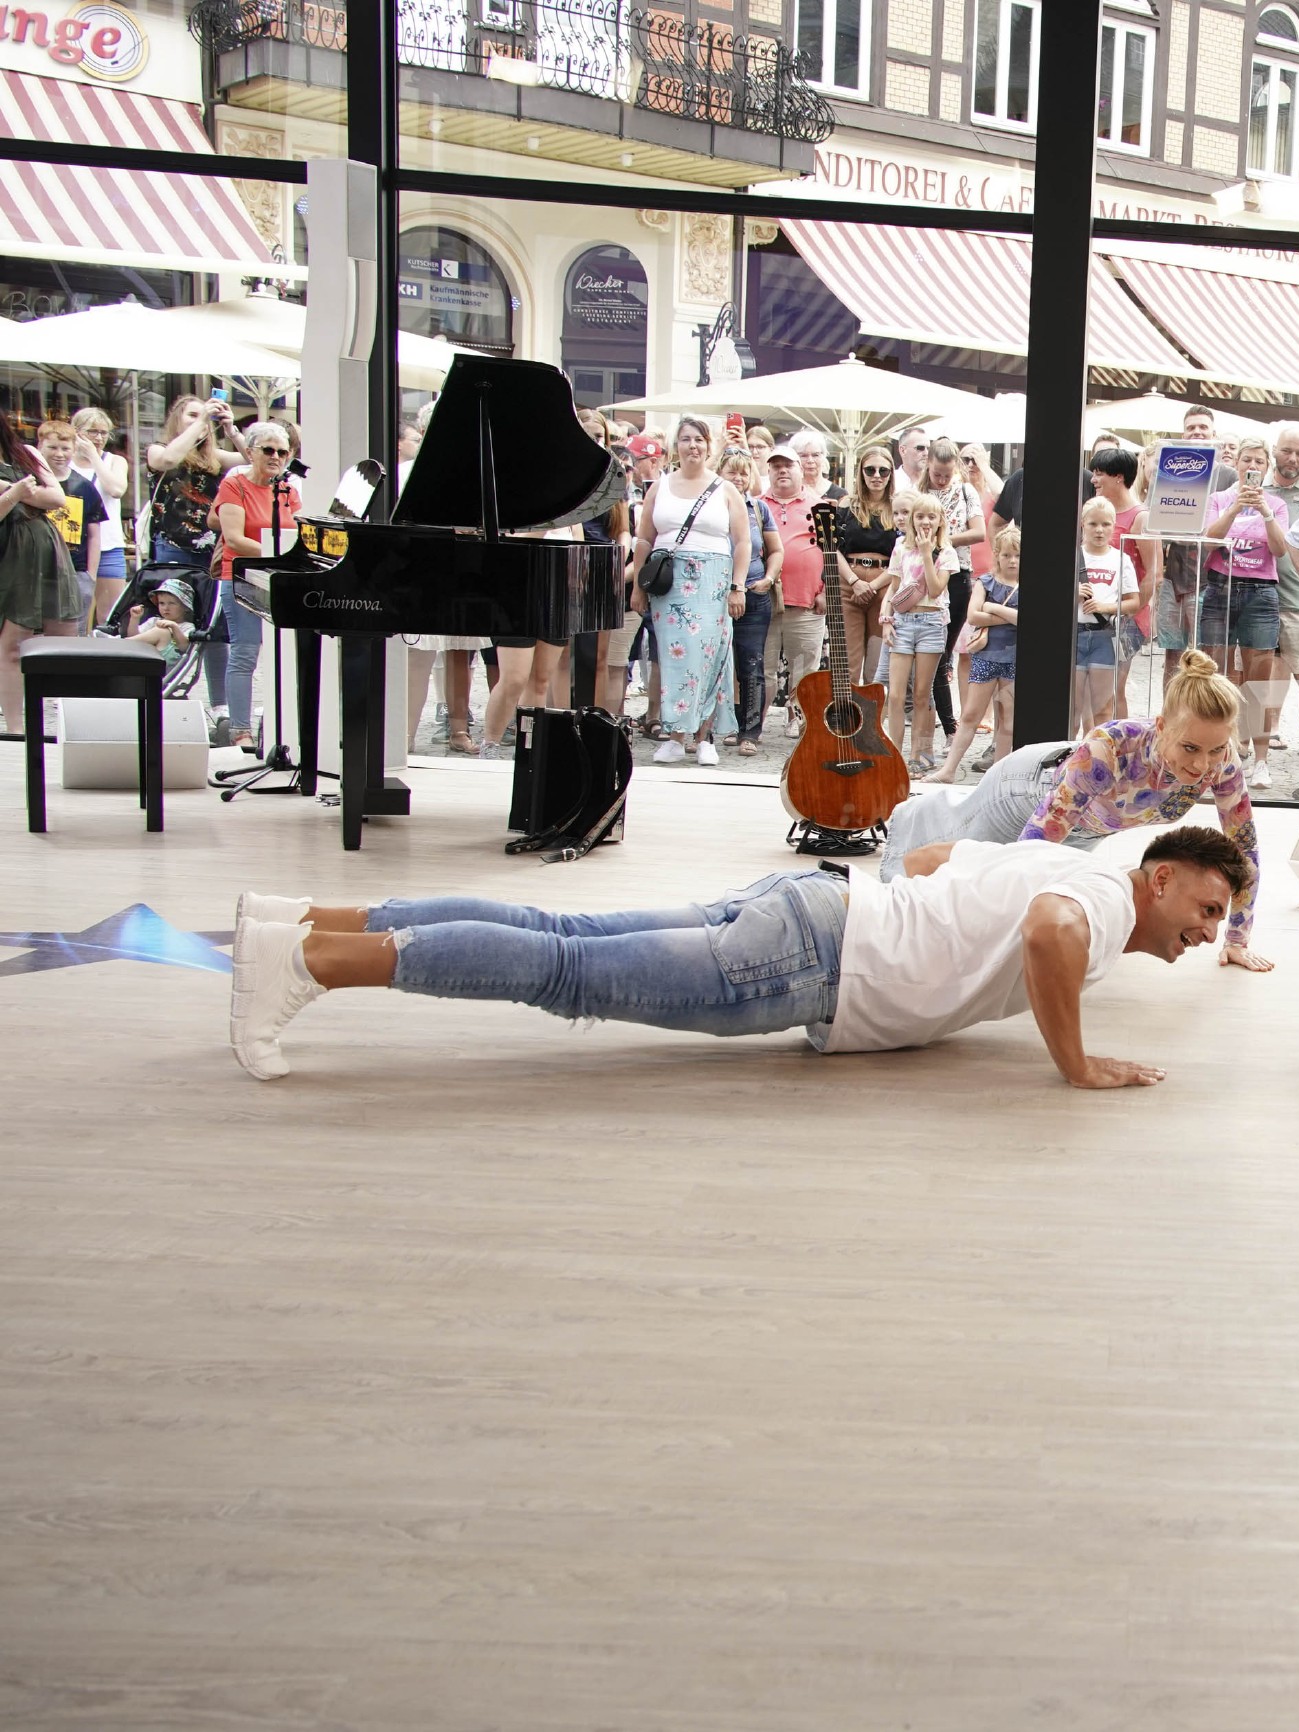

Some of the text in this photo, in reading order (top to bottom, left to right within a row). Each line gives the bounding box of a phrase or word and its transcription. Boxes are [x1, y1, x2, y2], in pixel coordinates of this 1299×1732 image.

[800, 150, 948, 204] NDITOREI
[954, 175, 972, 209] &
[430, 284, 490, 298] Kaufmännische
[430, 295, 482, 307] Krankenkasse
[1160, 497, 1197, 507] RECALL
